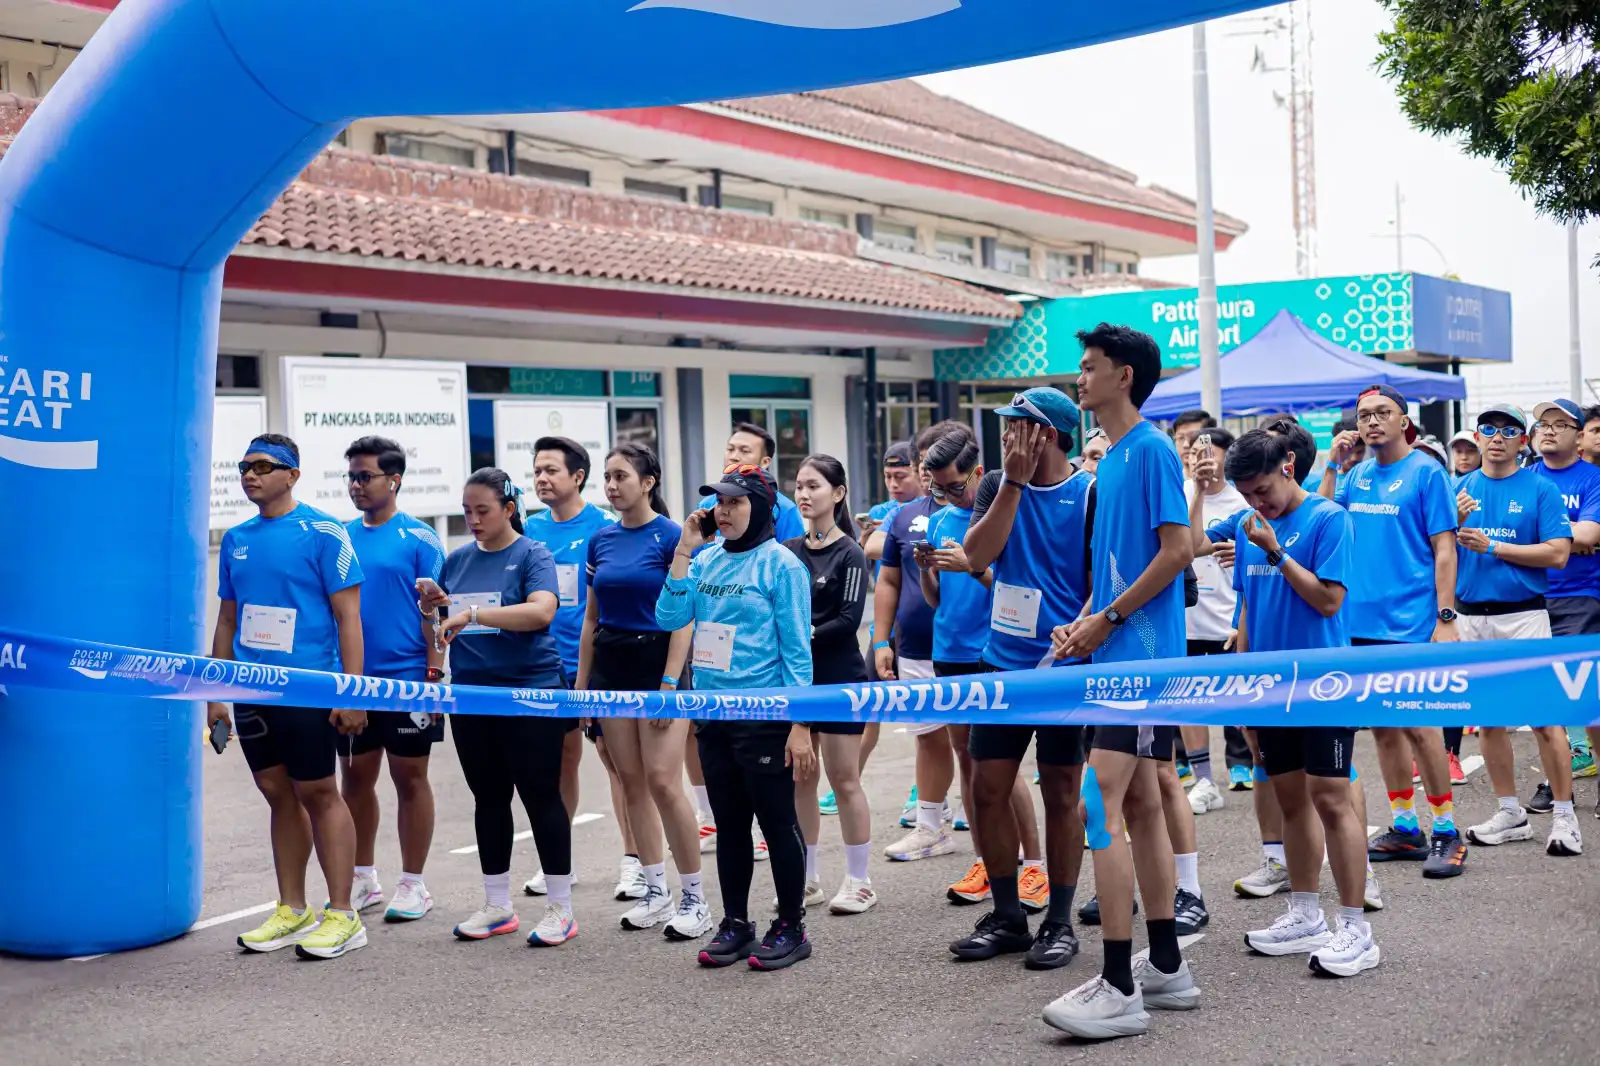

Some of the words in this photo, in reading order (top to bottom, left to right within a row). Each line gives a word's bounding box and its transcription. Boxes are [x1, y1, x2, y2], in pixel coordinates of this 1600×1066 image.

[1152, 299, 1255, 323] Pattiura
[0, 366, 91, 400] ARI
[304, 412, 318, 426] PT
[321, 412, 372, 426] ANGKASA
[375, 412, 402, 425] PURA
[405, 412, 456, 426] INDONESIA
[73, 649, 113, 661] POCARI
[70, 657, 106, 669] SWEAT
[1086, 676, 1150, 690] POCARI
[511, 689, 556, 701] SWEAT
[841, 680, 1010, 712] VIRTUAL
[1084, 688, 1144, 700] SWEAT
[1382, 700, 1393, 708] by
[1396, 701, 1423, 710] SMBC
[1425, 701, 1472, 710] Indonesia
